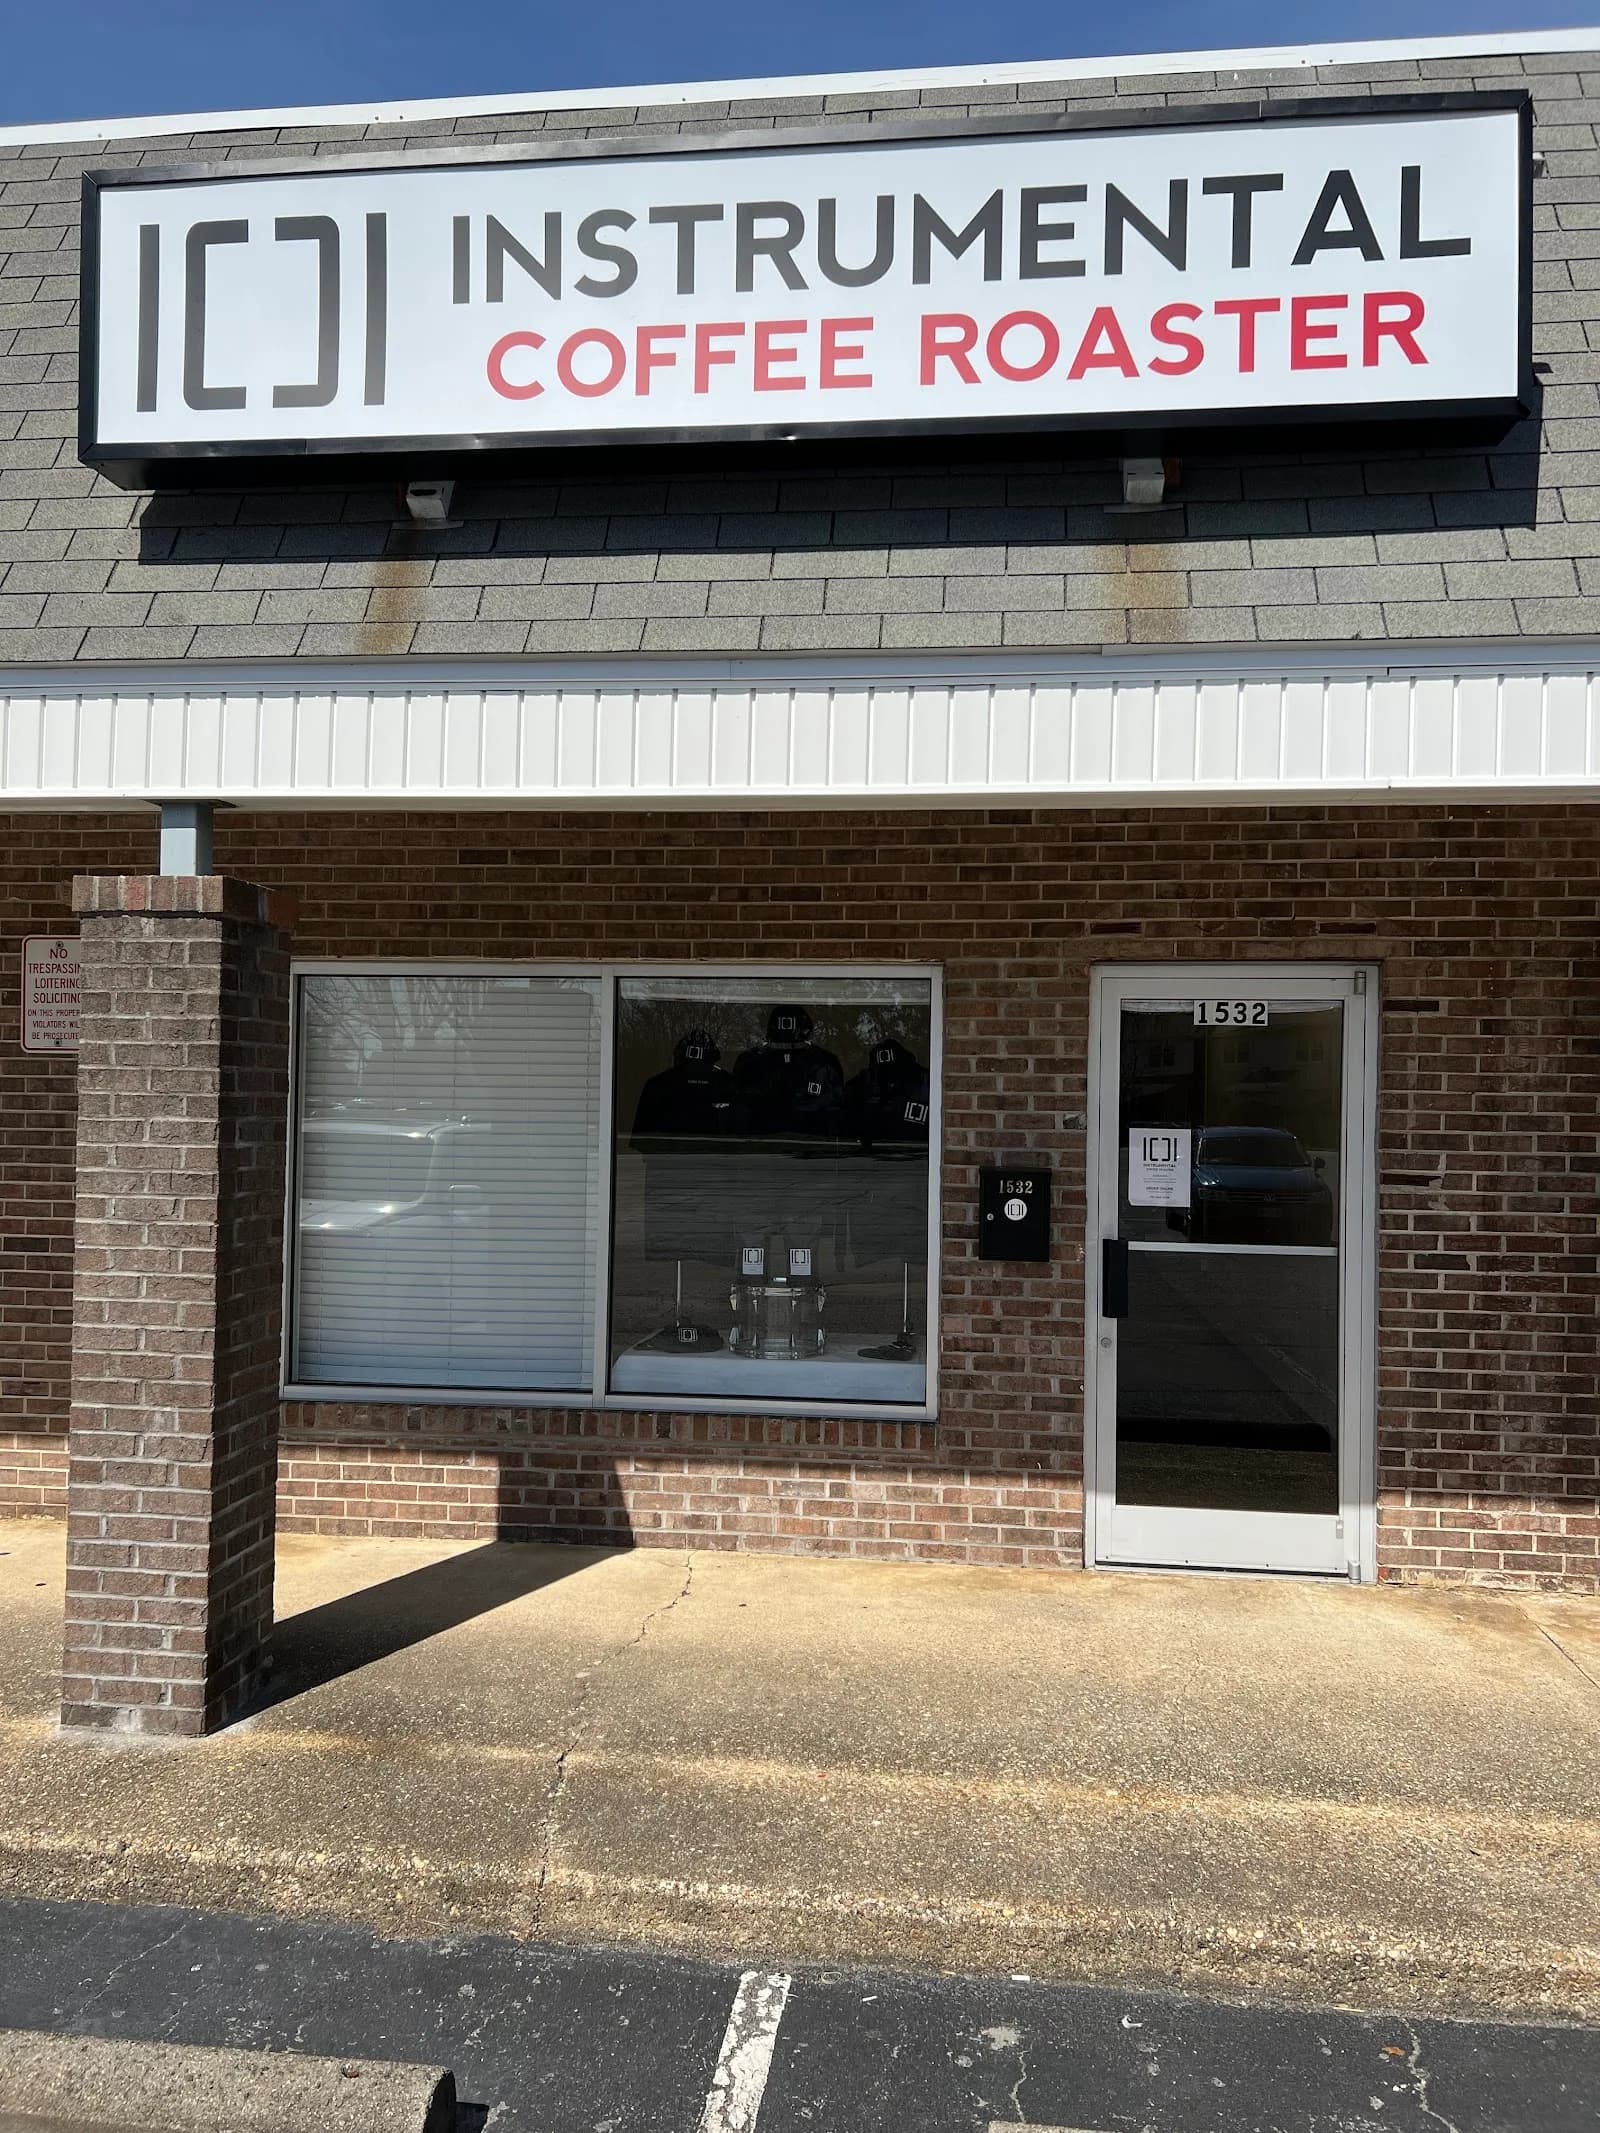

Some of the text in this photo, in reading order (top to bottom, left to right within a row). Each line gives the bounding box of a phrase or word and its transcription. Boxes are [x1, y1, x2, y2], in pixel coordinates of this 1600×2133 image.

[451, 165, 1472, 305] INSTRUMENTAL
[486, 290, 1430, 401] COFFEE ROASTER
[49, 948, 68, 959] NO
[28, 963, 81, 974] TRESPASSIN
[28, 1009, 80, 1017] ON THIS PROPER
[1197, 1001, 1267, 1025] 1532
[32, 1020, 80, 1029] VIOLATORS WIL
[32, 1031, 80, 1040] BE PROSECUTE
[999, 1179, 1033, 1194] 1532
